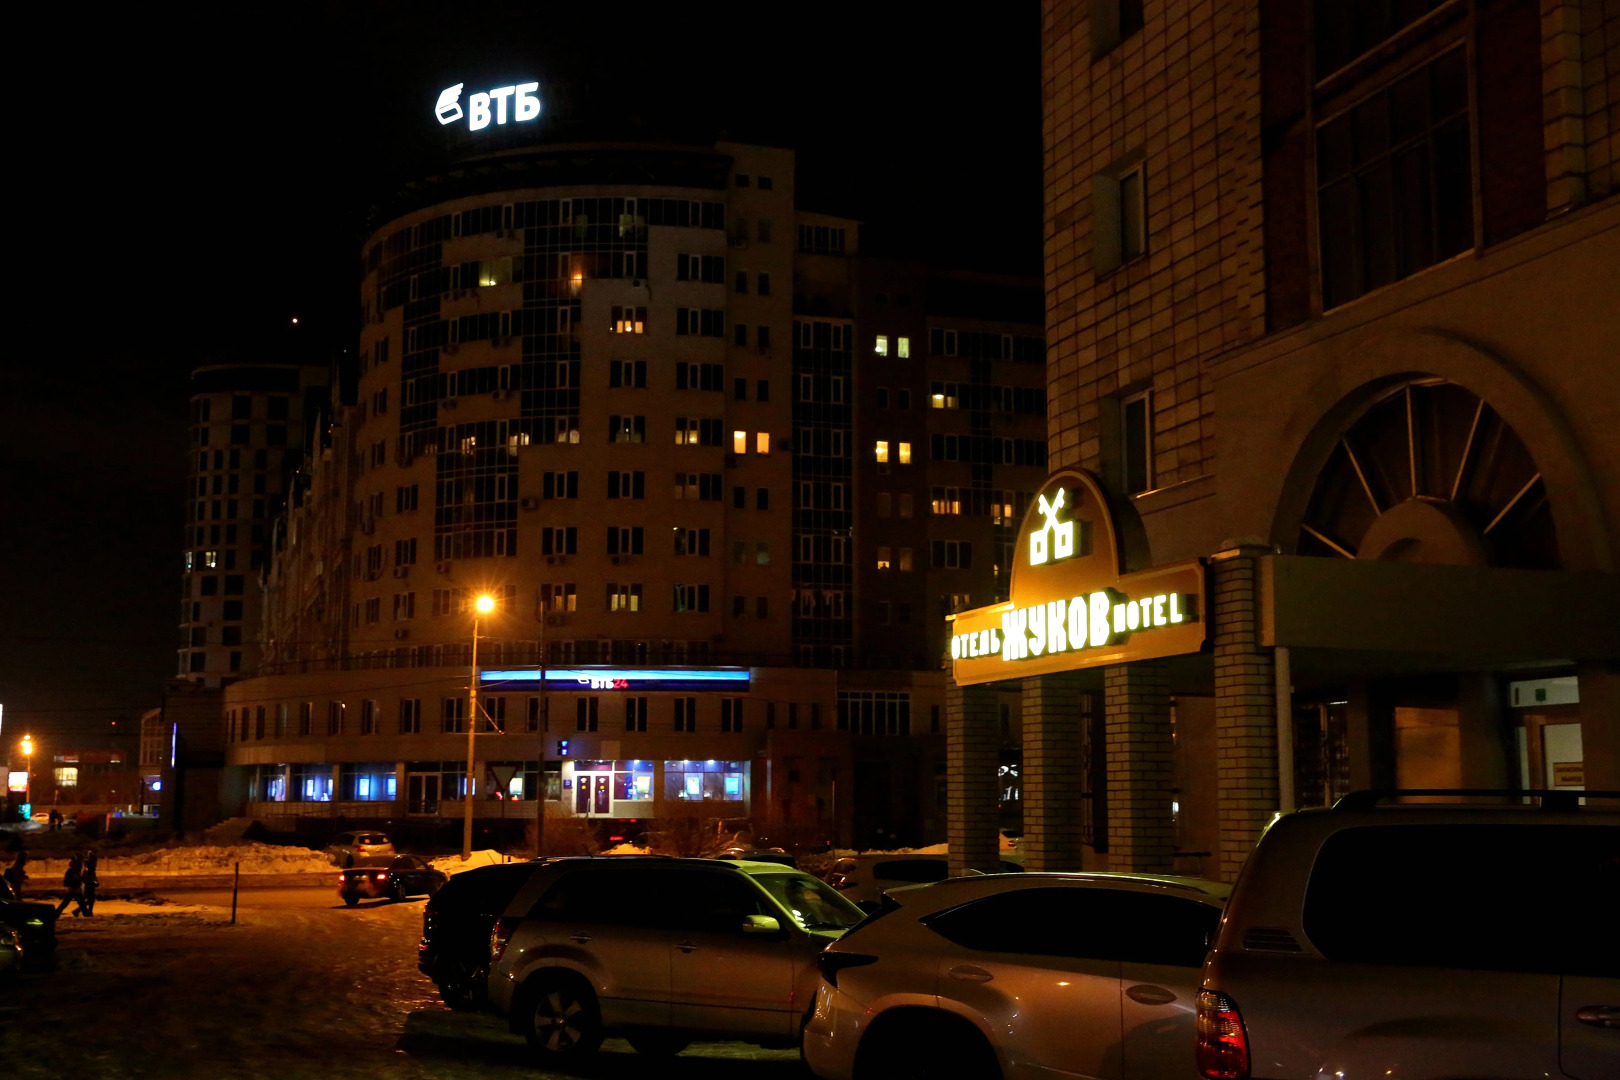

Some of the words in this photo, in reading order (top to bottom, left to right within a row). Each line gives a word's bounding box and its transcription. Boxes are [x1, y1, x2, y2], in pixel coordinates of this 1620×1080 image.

[469, 81, 541, 132] ВТБ
[951, 628, 1000, 660] ОТЕЛЬ
[1002, 591, 1110, 662] ЖУКОВ
[1113, 592, 1184, 634] HOTEL
